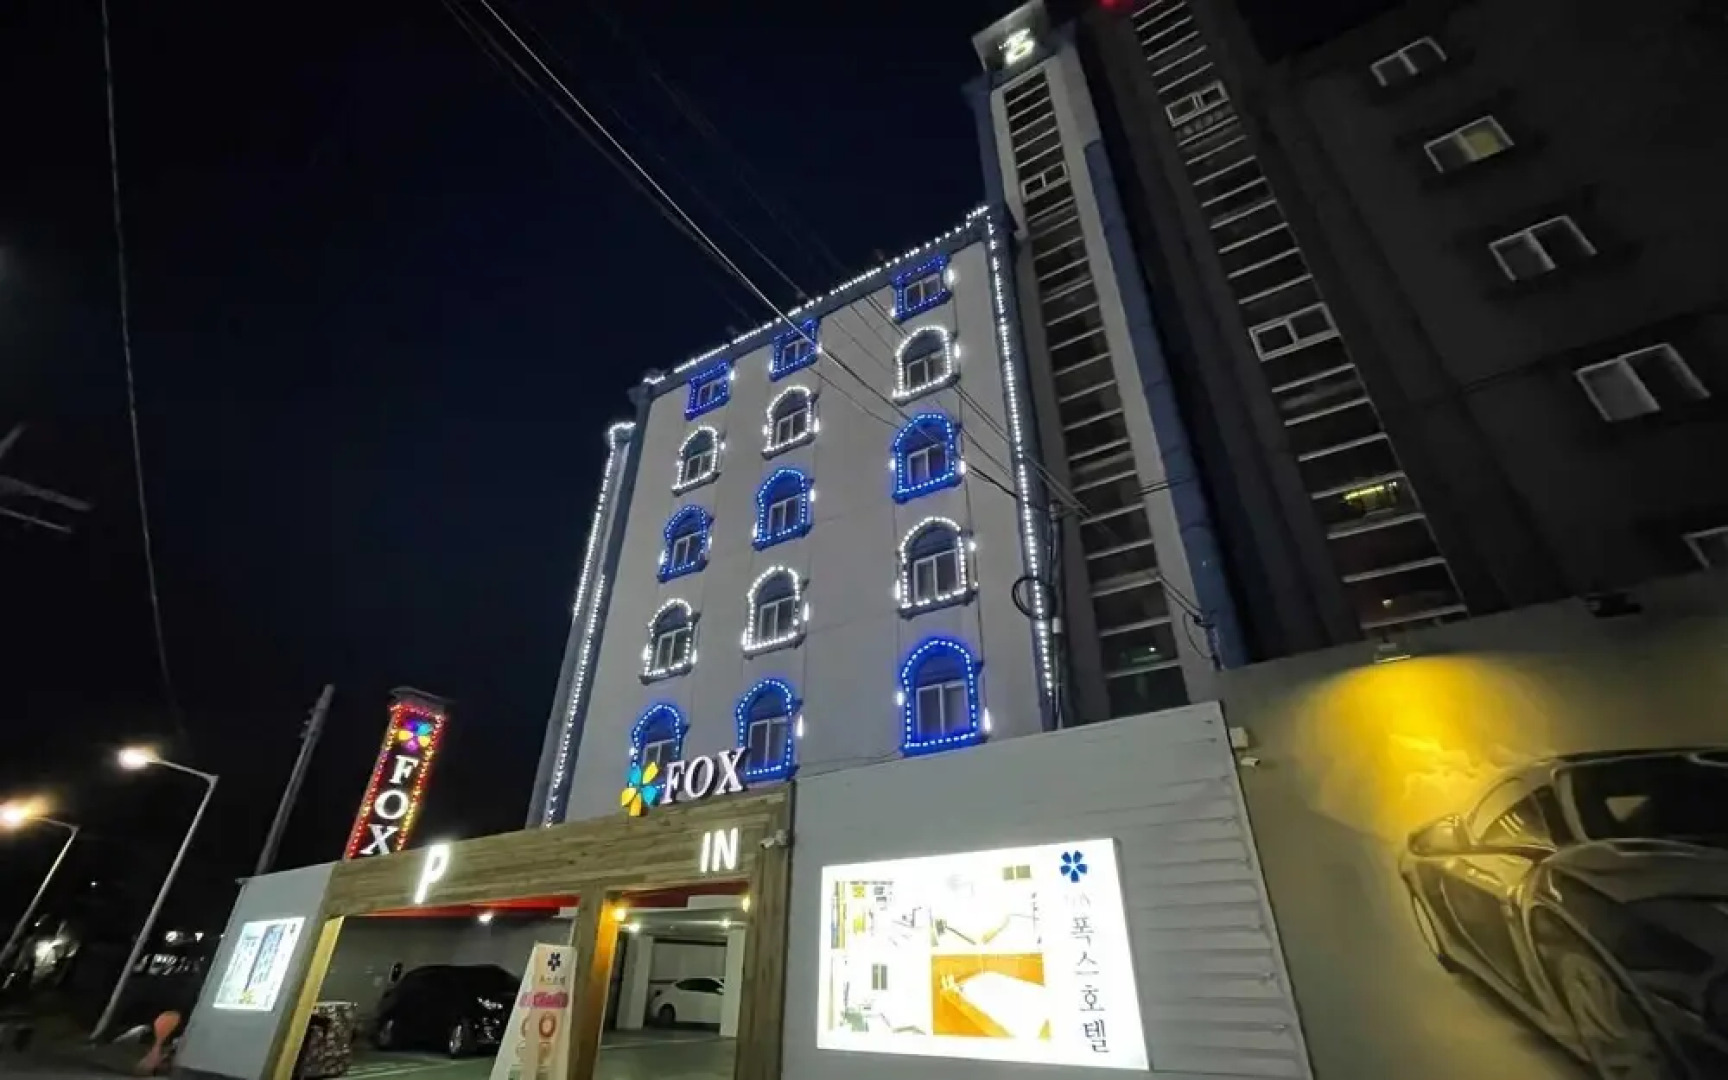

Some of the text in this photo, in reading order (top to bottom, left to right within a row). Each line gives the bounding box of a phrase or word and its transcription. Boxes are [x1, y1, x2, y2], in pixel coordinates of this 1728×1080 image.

[360, 754, 419, 855] FOX
[660, 746, 746, 805] FOX
[413, 843, 450, 905] P
[700, 827, 739, 873] IN
